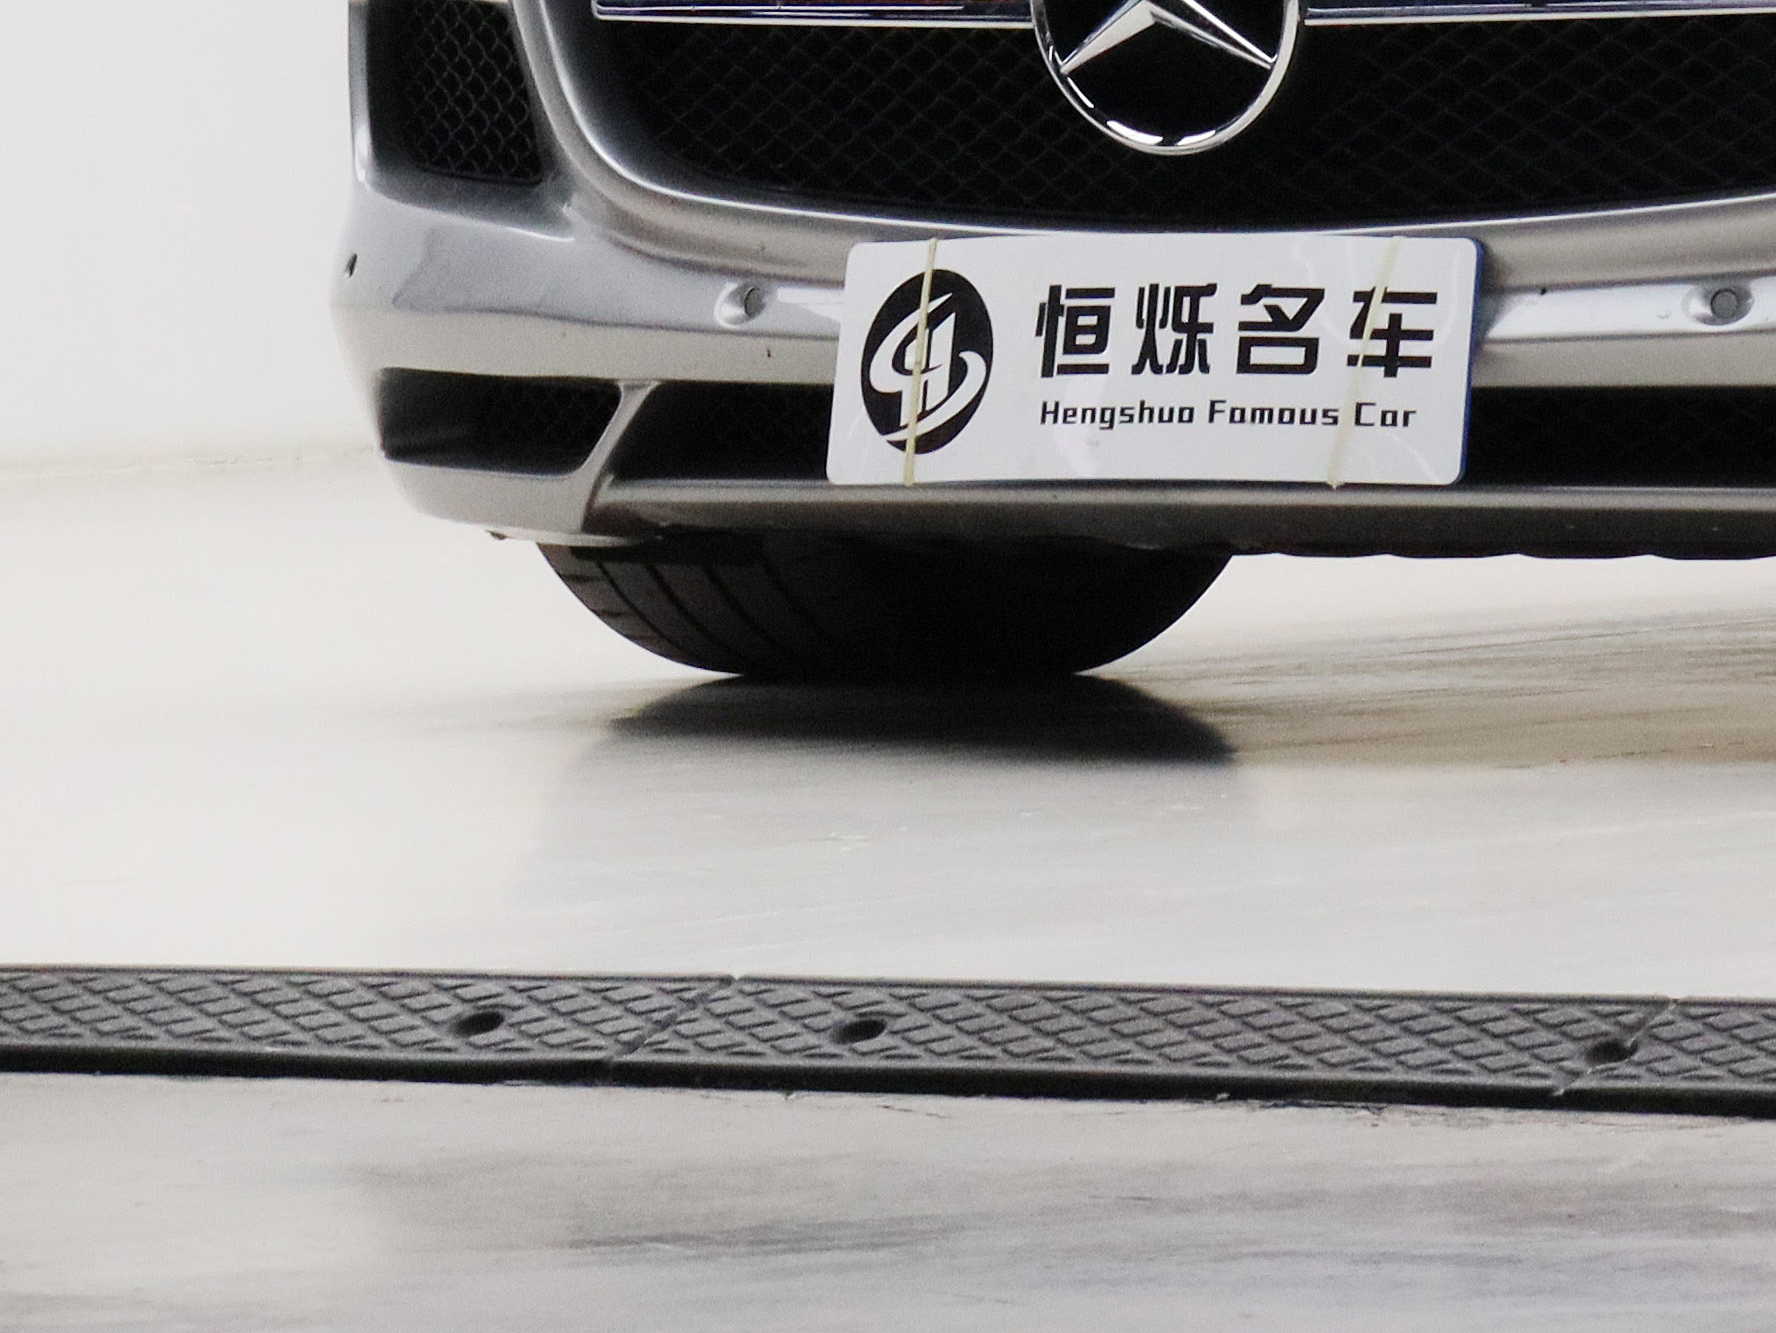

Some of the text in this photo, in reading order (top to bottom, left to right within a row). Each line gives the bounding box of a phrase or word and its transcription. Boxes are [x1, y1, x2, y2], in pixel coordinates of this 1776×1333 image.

[1035, 282, 1438, 378] 恒烁名车
[1040, 399, 1417, 431] Hengshuo Famous Car
